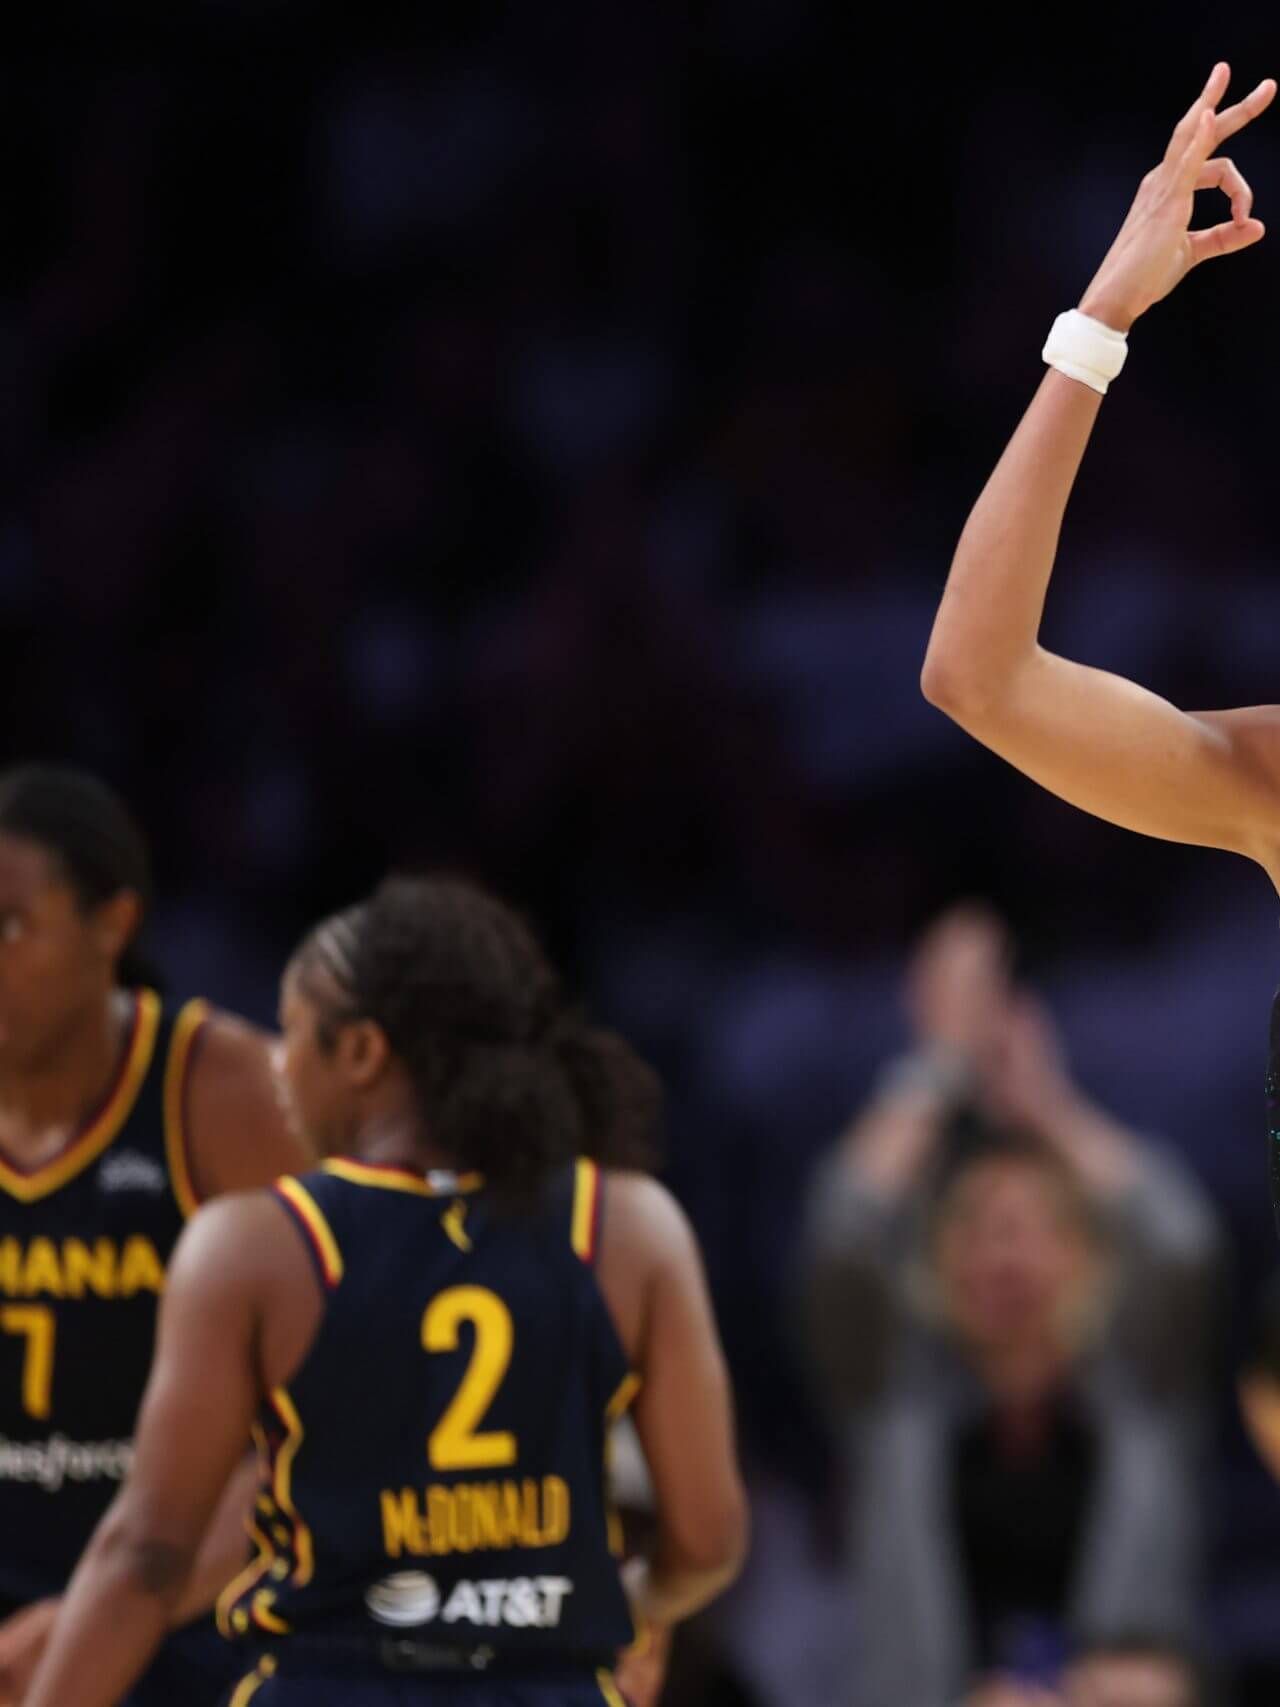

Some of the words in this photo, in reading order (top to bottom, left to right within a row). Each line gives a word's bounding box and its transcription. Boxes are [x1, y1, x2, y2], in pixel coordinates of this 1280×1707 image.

[1, 1306, 55, 1418] 7
[421, 1286, 517, 1469] 2
[380, 1476, 571, 1558] McDONALD
[440, 1576, 574, 1627] AT&T
